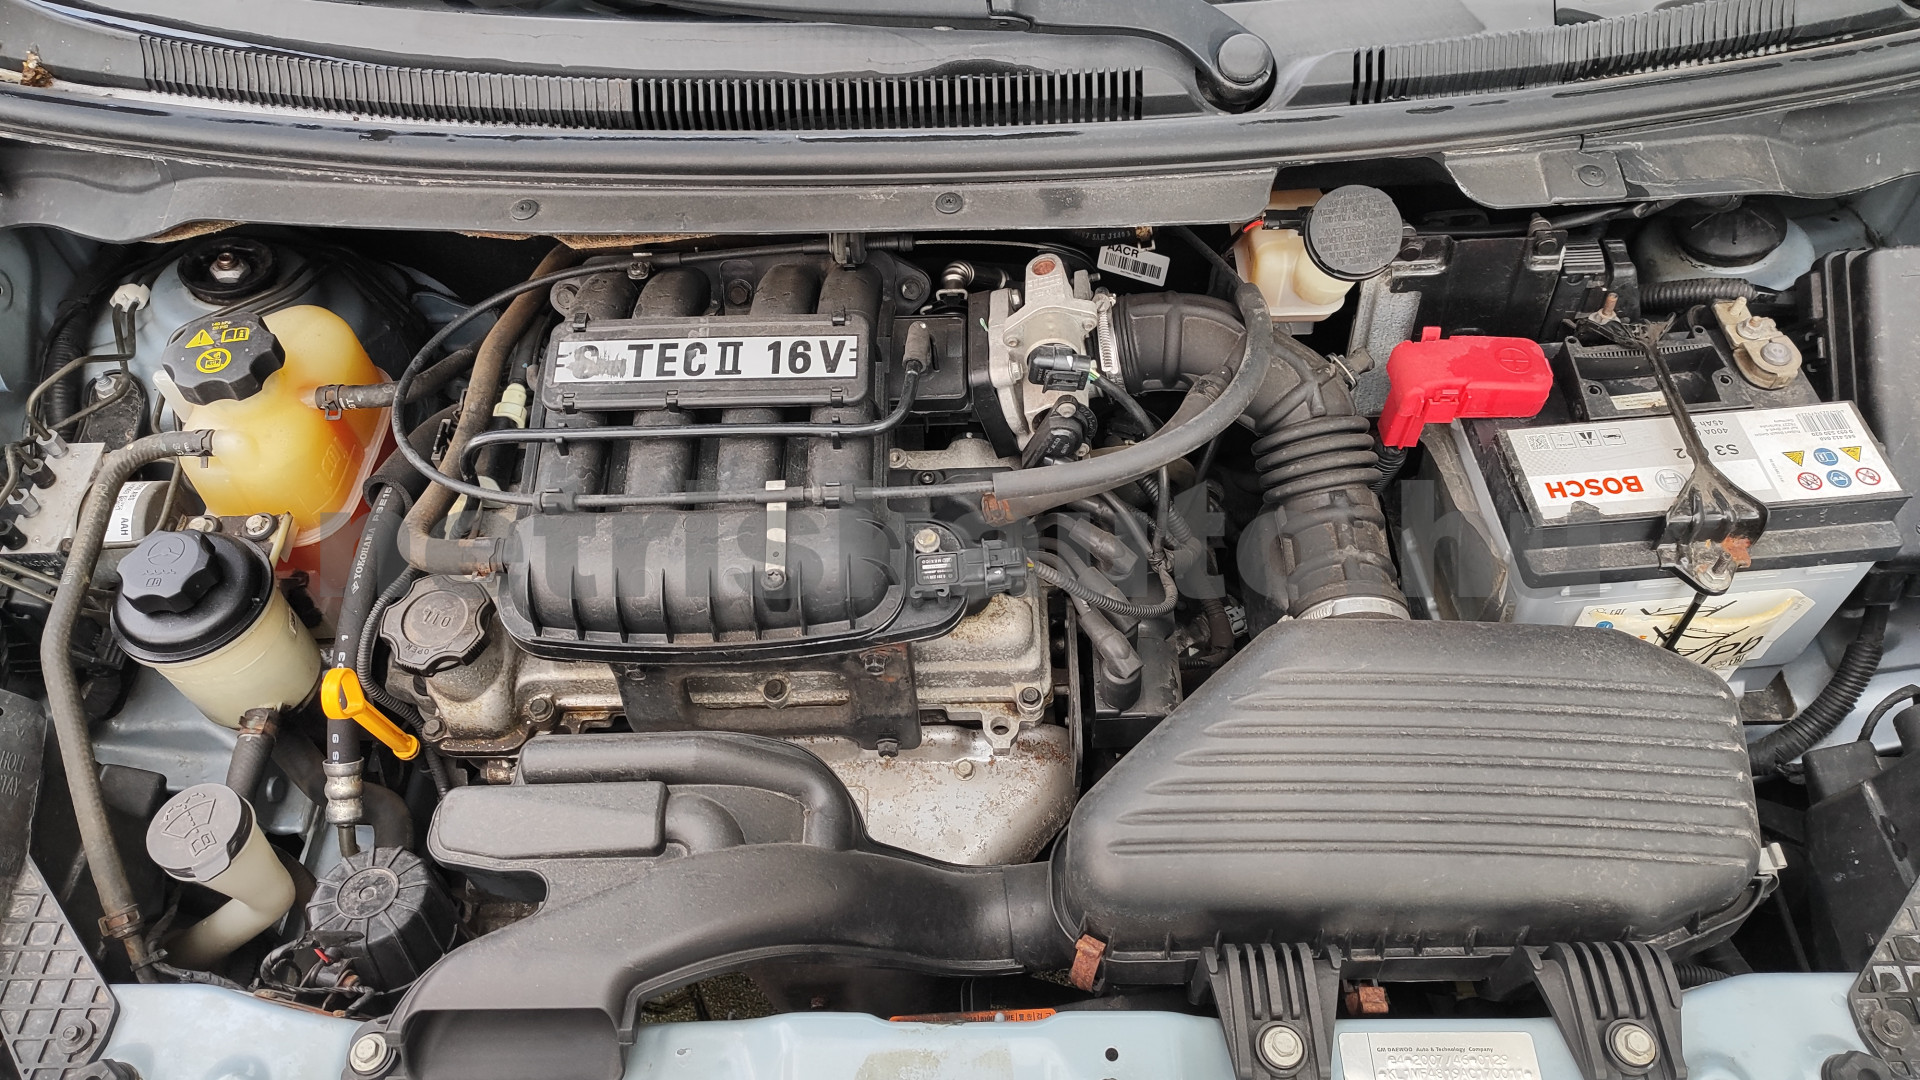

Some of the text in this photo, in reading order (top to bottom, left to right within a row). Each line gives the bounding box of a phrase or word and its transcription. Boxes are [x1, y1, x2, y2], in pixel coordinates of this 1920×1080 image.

[766, 339, 847, 376] 16V
[1714, 443, 1740, 456] S3
[1544, 474, 1644, 499] BOSCH
[353, 527, 376, 580] YOKOHAMA
[422, 607, 452, 628] OIL
[404, 643, 430, 655] OPEN
